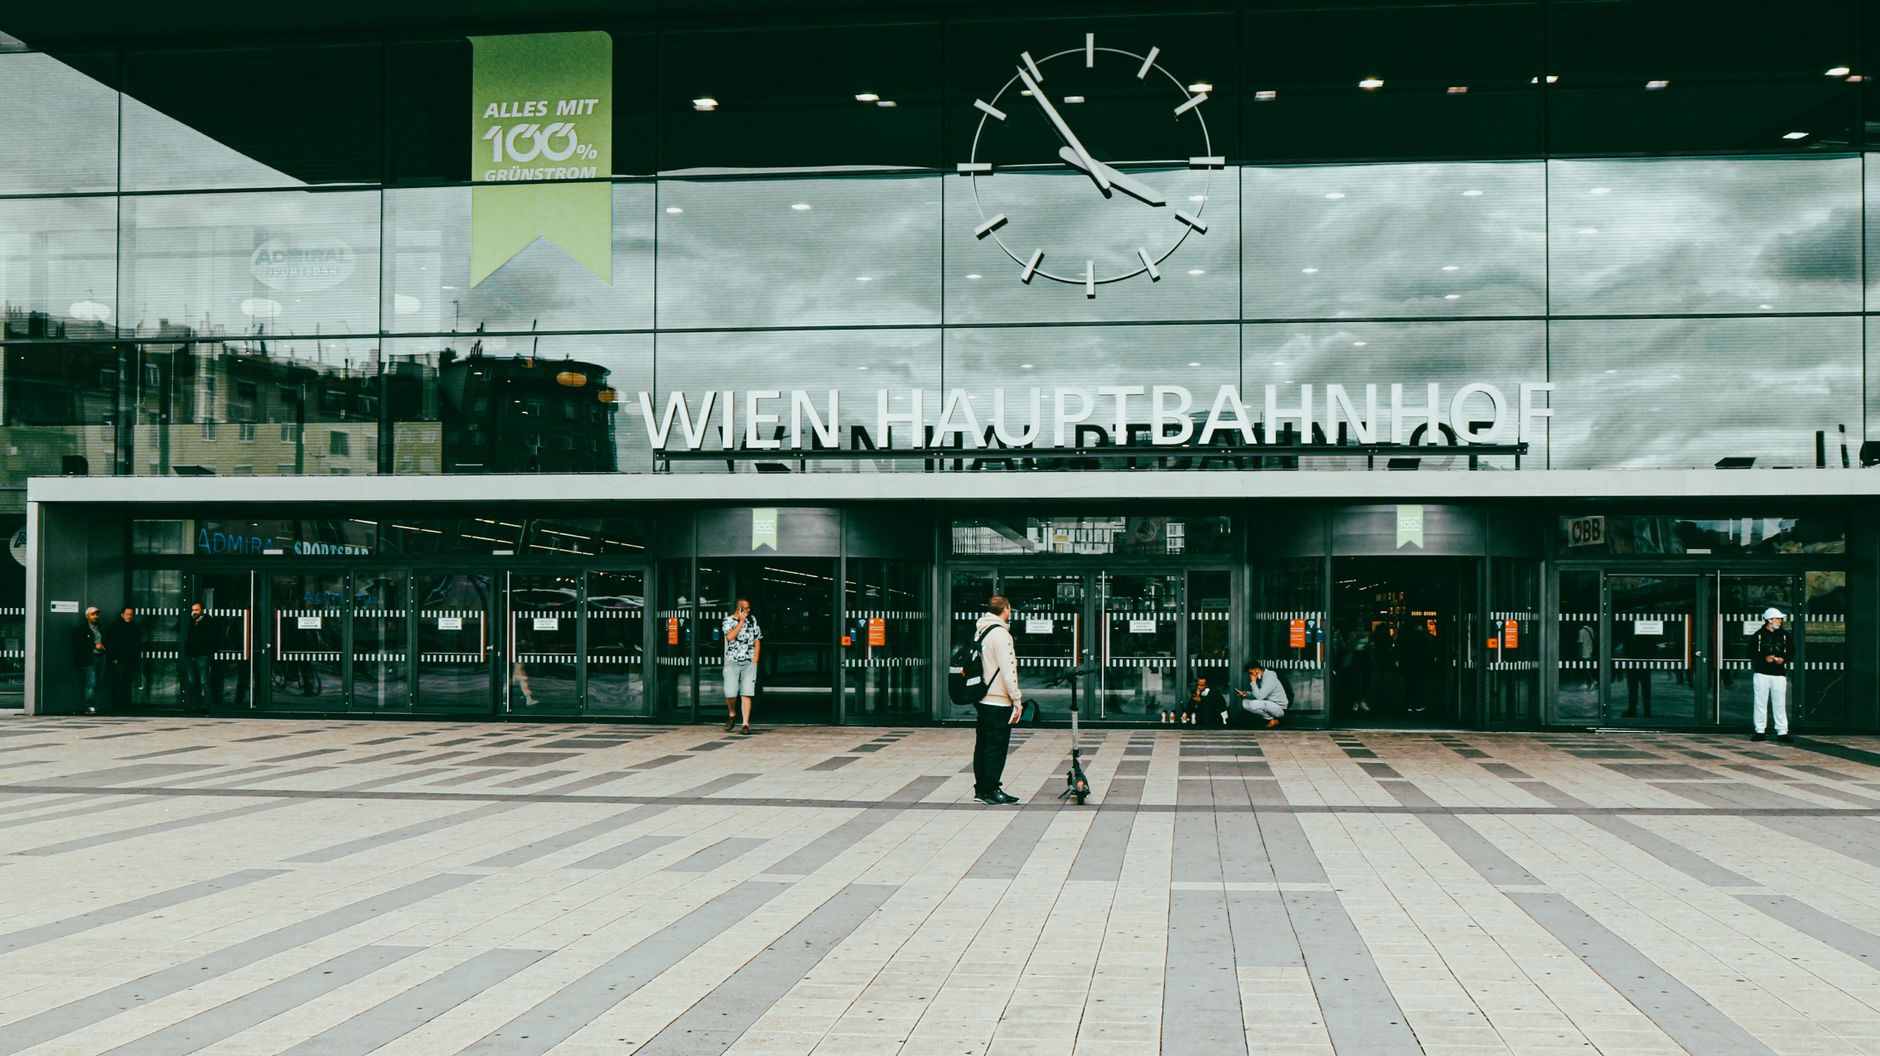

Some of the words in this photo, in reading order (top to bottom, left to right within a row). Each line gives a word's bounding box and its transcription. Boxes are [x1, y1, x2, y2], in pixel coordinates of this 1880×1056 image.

[483, 101, 548, 119] ALLES
[556, 98, 599, 116] MIT
[482, 122, 598, 163] 100%
[484, 165, 598, 181] GRÜNSTROM
[638, 389, 840, 449] WIEN
[877, 382, 1556, 449] HAUPTBAHNHOF
[198, 527, 273, 555] ADMIRA
